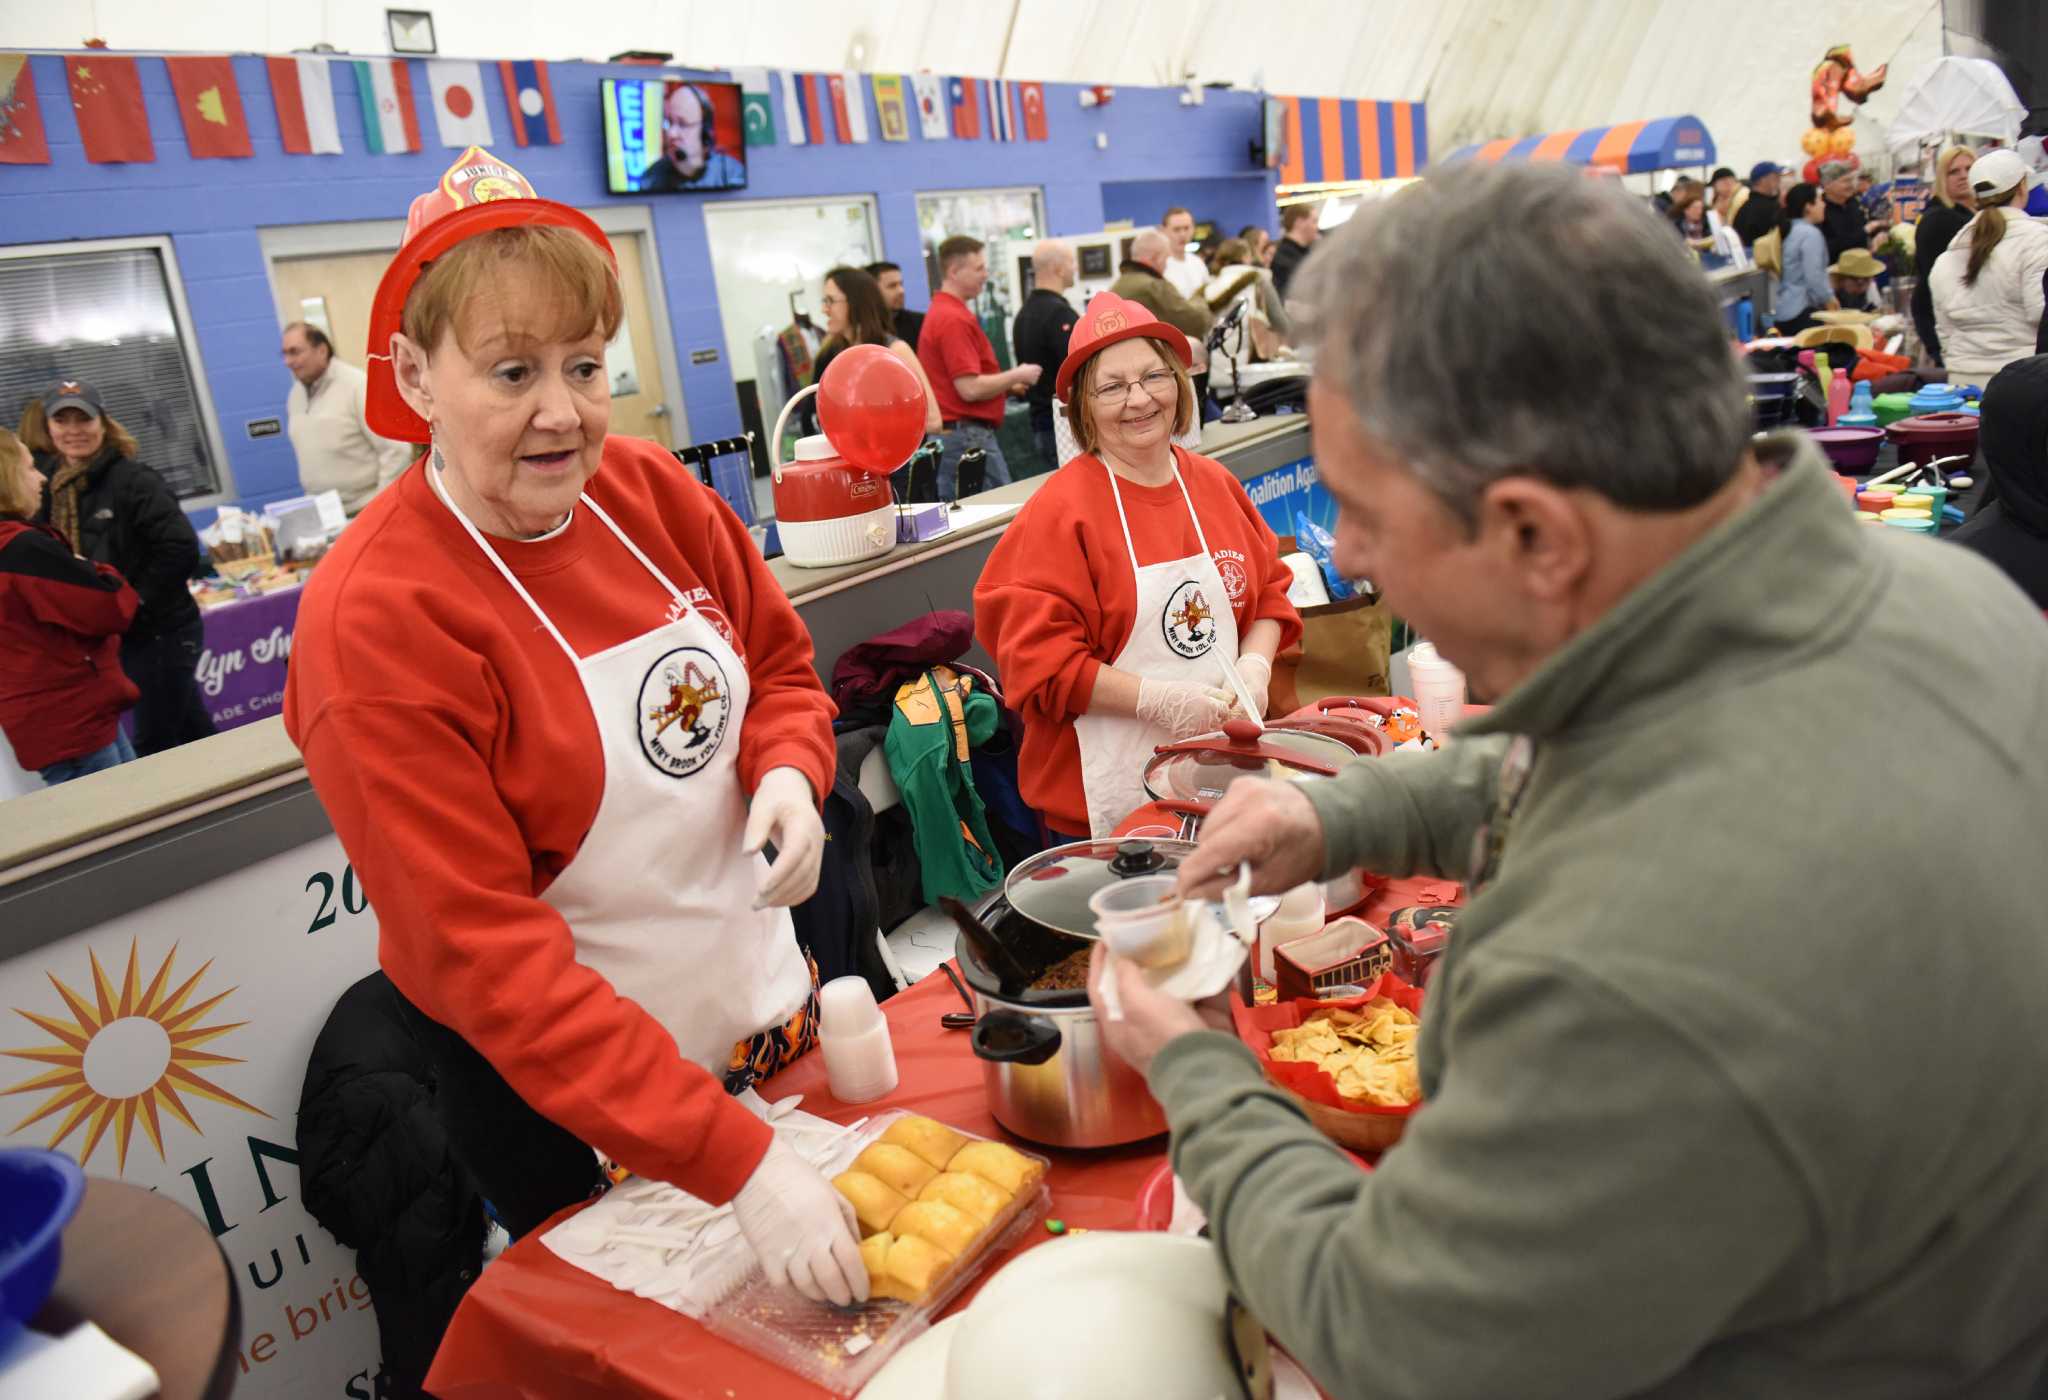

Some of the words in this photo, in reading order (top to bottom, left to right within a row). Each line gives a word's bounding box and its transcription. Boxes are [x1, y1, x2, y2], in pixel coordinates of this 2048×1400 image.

[1296, 463, 1320, 494] Aga
[1212, 549, 1245, 562] ADIES
[195, 648, 246, 697] lyn
[212, 703, 246, 723] ADE
[248, 691, 283, 711] CHO
[650, 737, 670, 761] MIRY
[669, 756, 697, 769] BROOK
[306, 863, 369, 934] 20
[180, 1136, 300, 1239] IN
[248, 1233, 311, 1290] UI
[284, 1275, 374, 1341] brig
